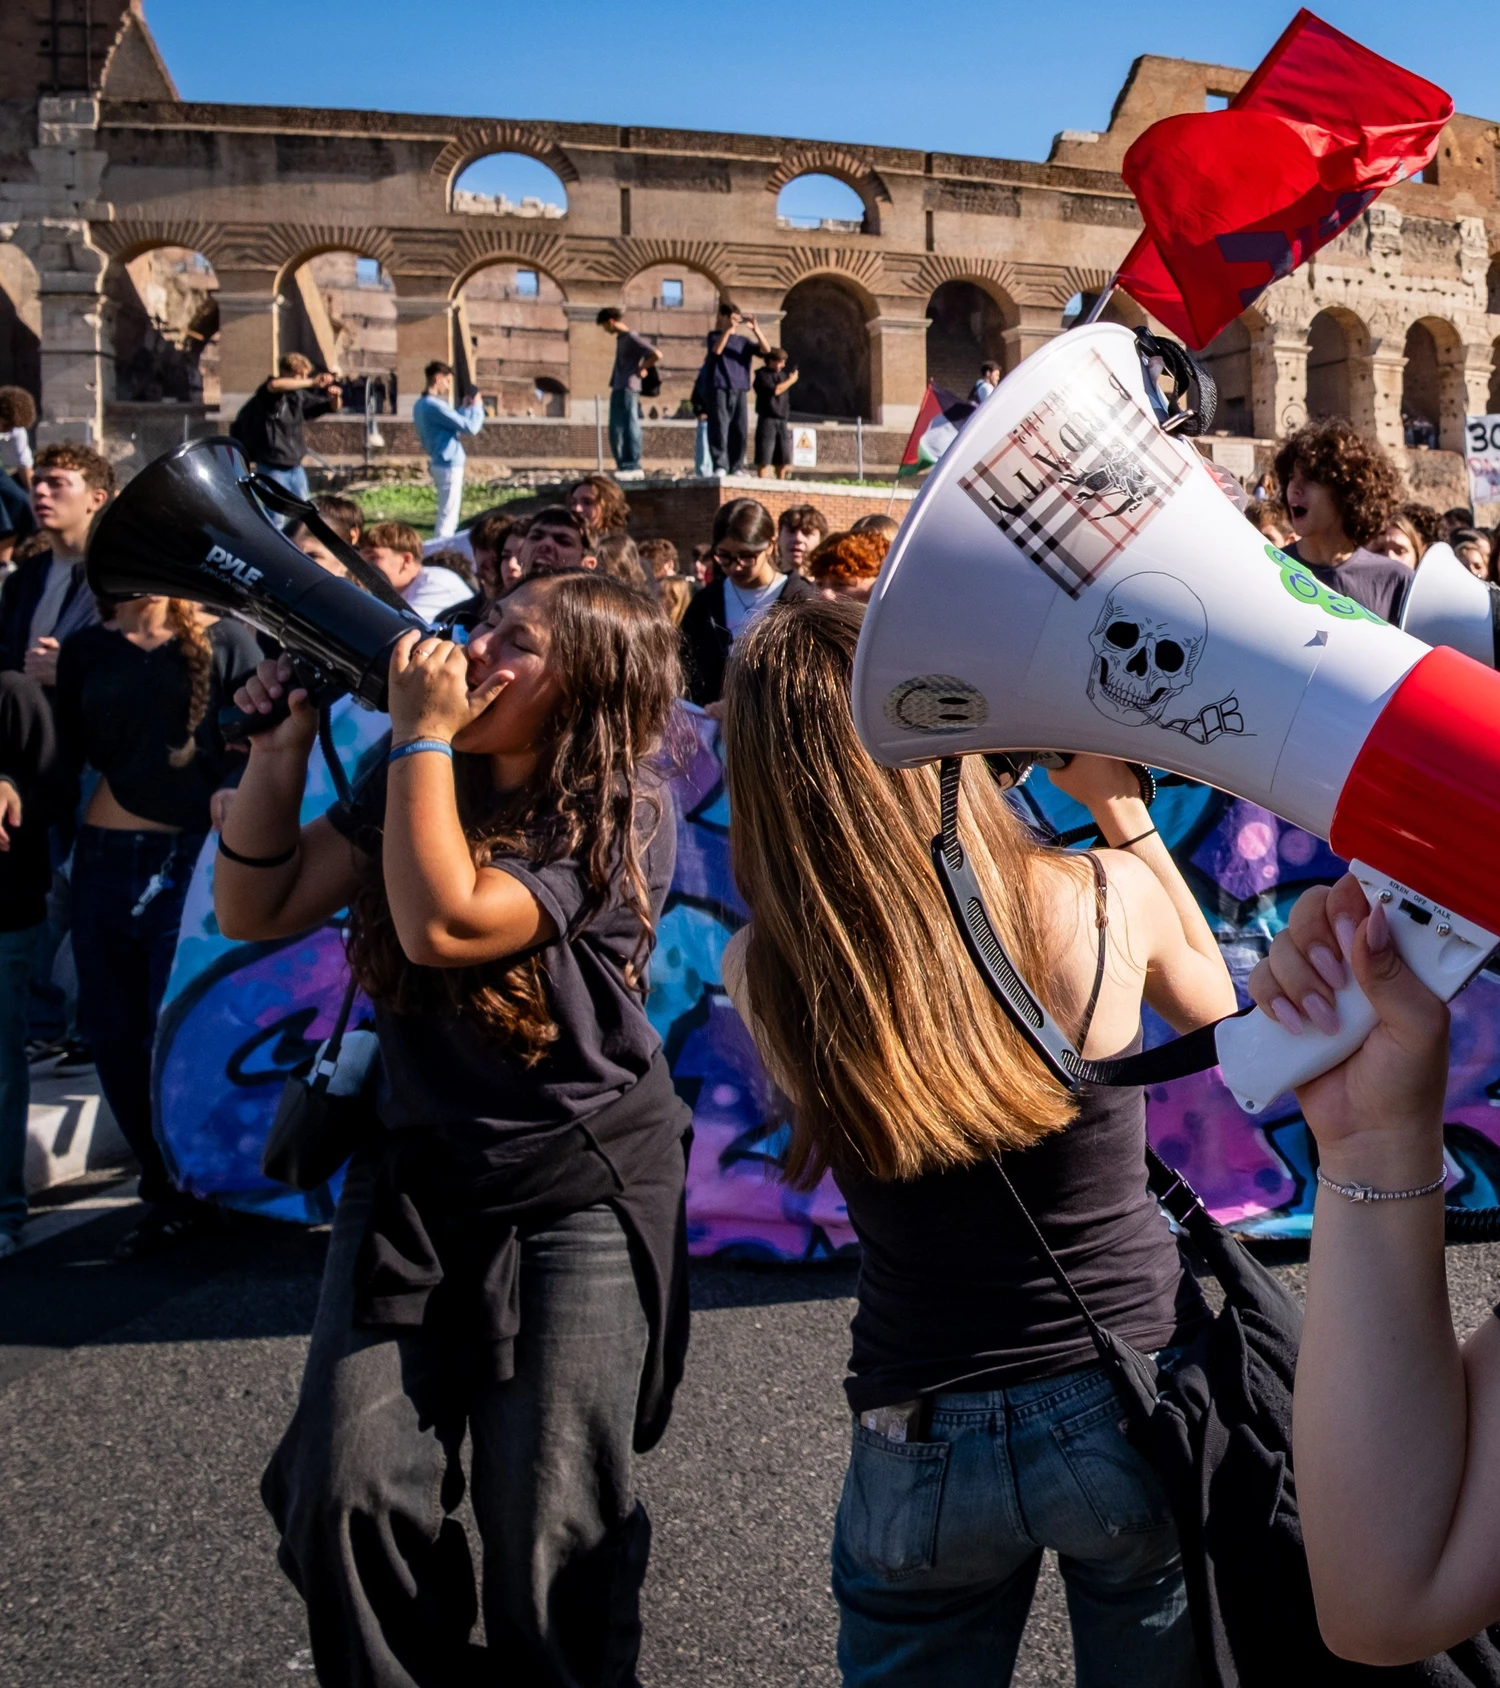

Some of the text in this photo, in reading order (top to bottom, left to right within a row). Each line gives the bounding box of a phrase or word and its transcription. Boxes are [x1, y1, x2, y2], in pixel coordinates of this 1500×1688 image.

[206, 544, 264, 587] PYLE
[1389, 880, 1452, 920] SIREN OFF TALK
